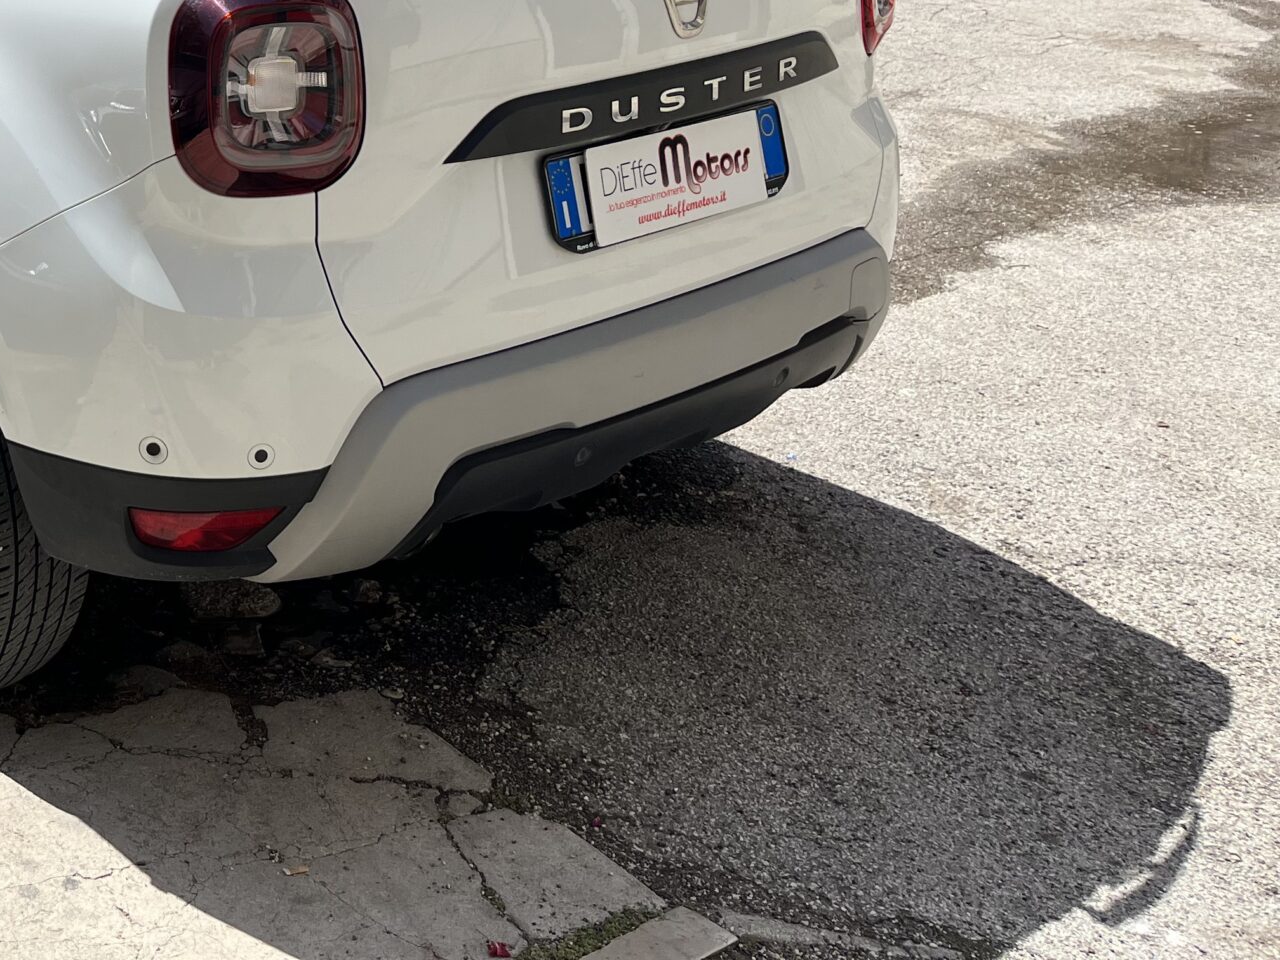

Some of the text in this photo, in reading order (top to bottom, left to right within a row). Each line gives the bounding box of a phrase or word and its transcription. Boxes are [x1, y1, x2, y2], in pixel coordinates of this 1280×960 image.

[561, 56, 798, 133] DUSTER
[658, 133, 751, 195] Motors
[562, 200, 571, 229] I
[638, 190, 727, 225] www.dieffemotors.it
